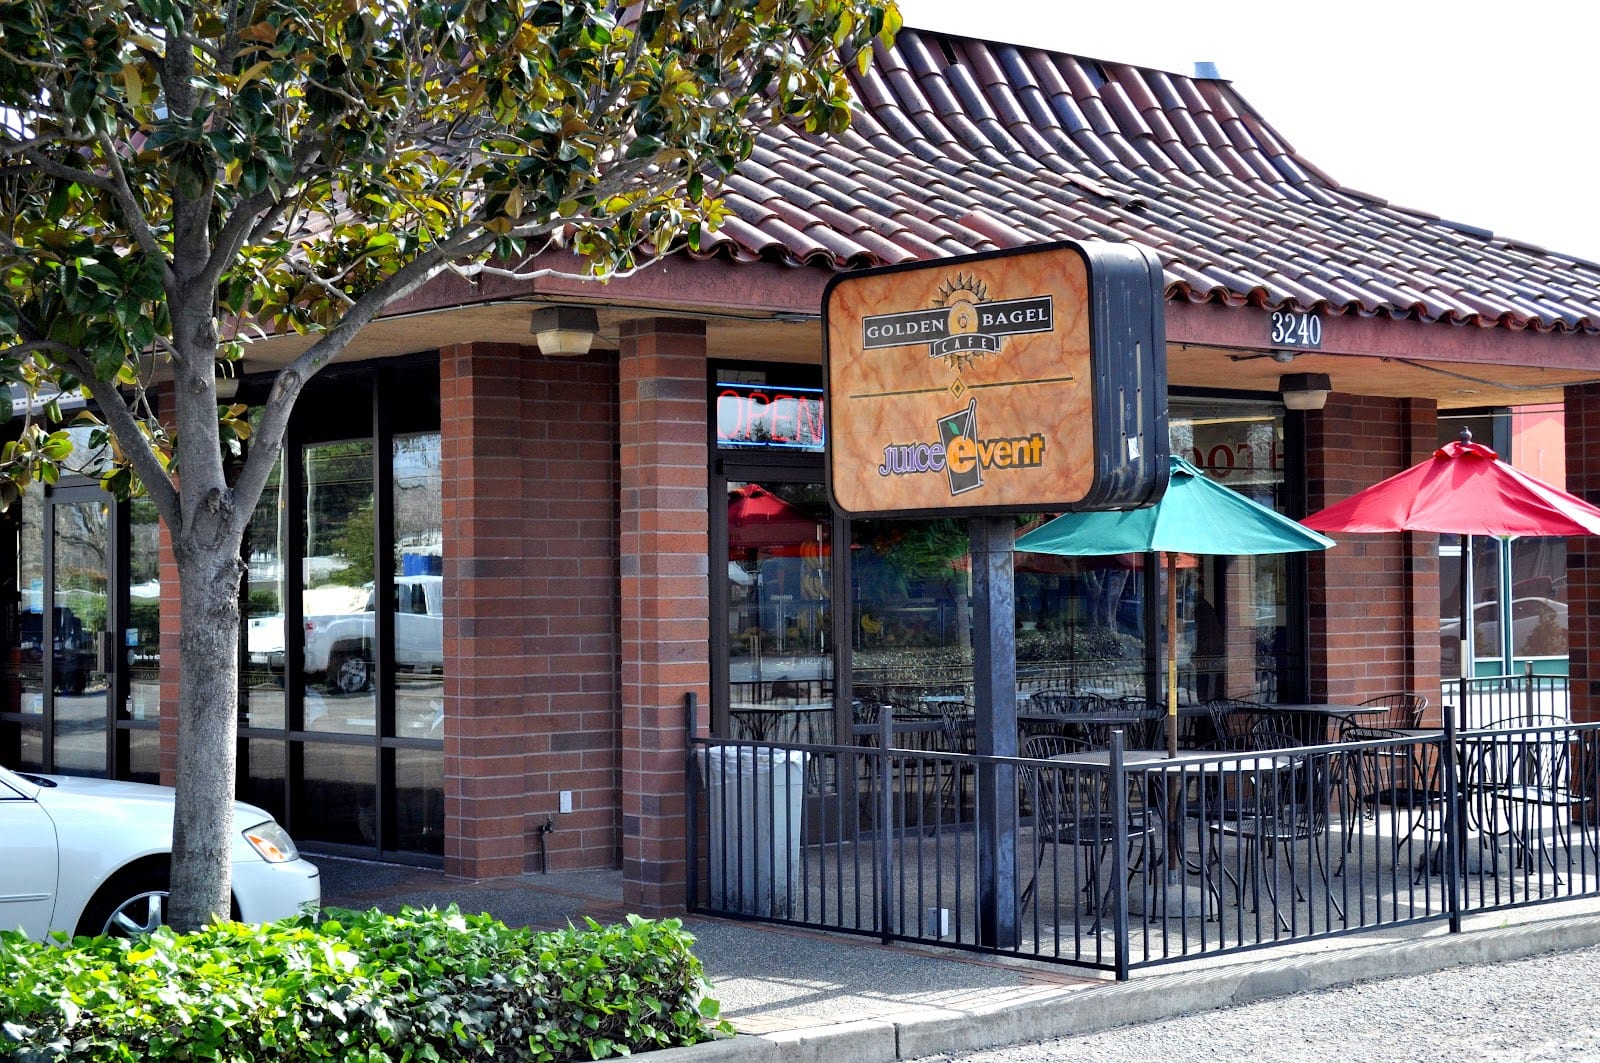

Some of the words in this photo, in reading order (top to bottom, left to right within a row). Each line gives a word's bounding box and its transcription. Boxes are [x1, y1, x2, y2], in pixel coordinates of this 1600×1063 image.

[866, 318, 945, 339] GOLDEN
[981, 307, 1048, 327] BAGEL
[1271, 311, 1321, 345] 3240
[941, 340, 988, 353] CAFE
[717, 389, 824, 443] OPEN
